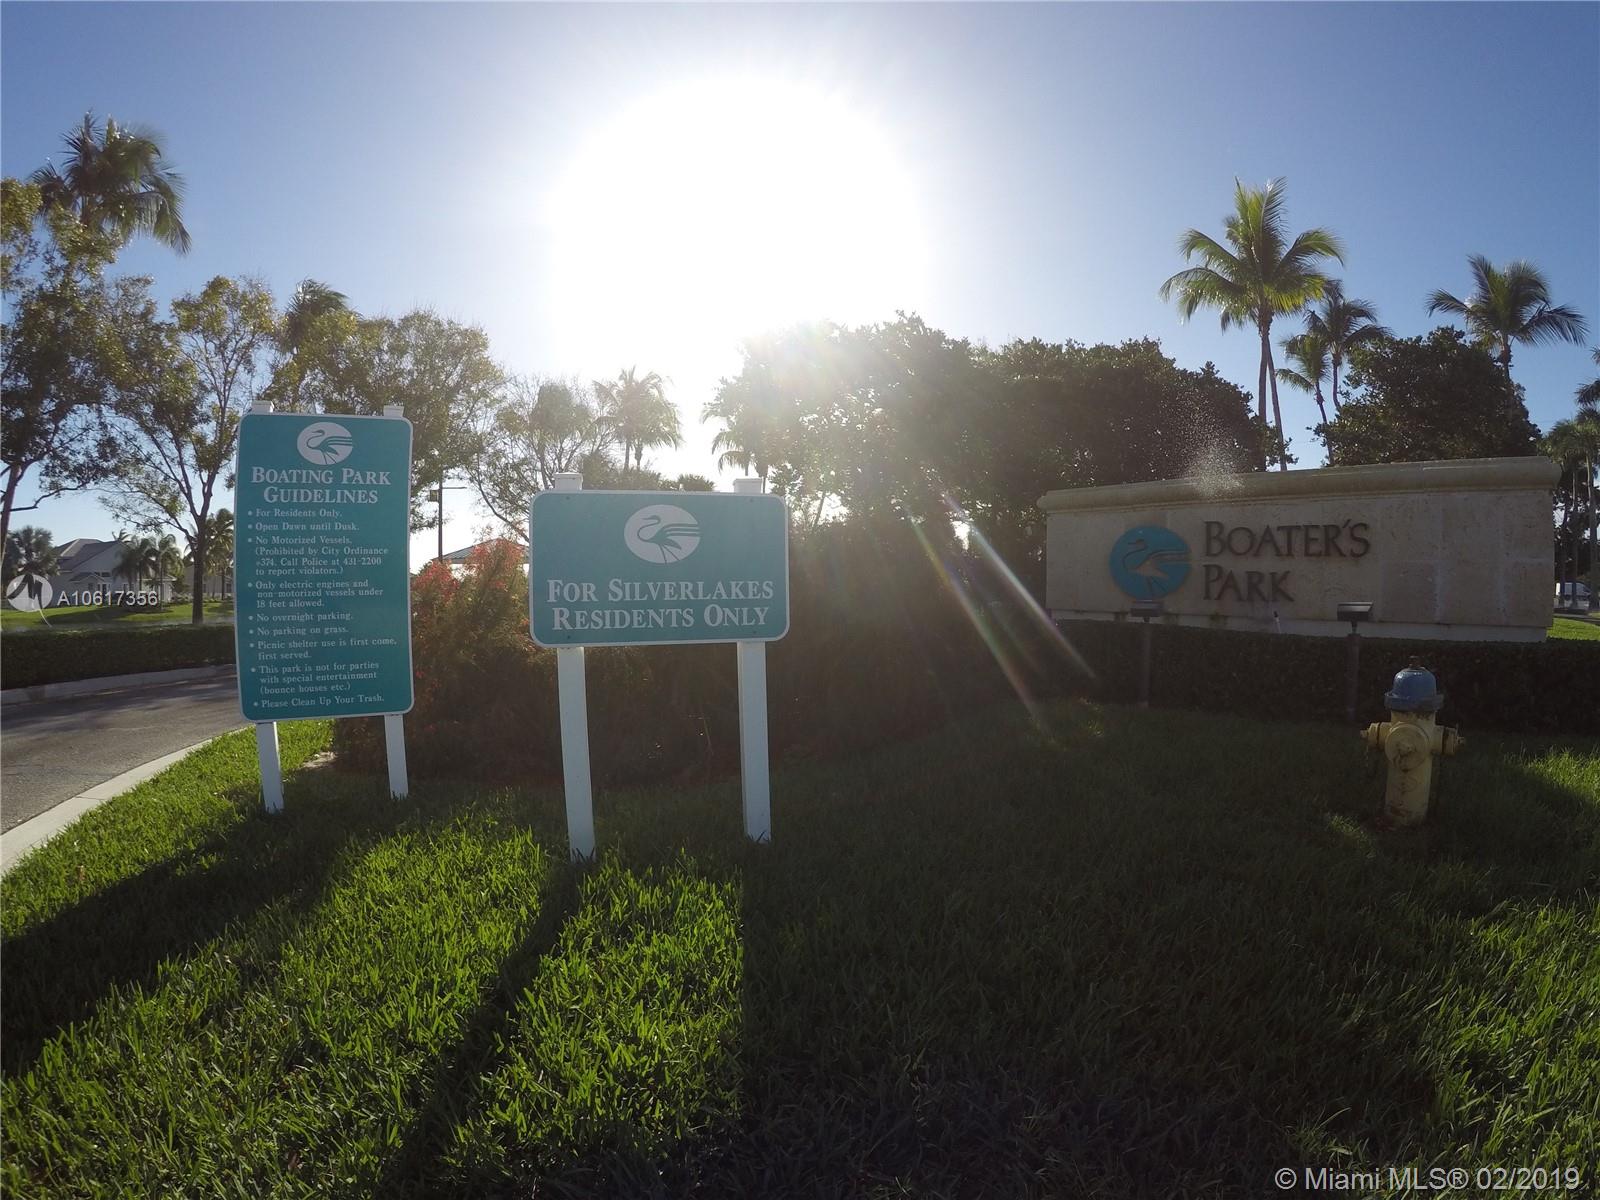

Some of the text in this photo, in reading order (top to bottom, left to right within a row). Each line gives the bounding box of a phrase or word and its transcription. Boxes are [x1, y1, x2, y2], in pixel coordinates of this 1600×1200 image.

[252, 466, 391, 486] BOATING PARK
[264, 486, 378, 504] GUIDELINES
[256, 508, 342, 519] For Residents Only.
[256, 523, 359, 532] Open Dawn until Dusk.
[256, 536, 268, 544] No
[272, 536, 315, 544] Motorized
[1201, 519, 1371, 558] BOATER'S
[309, 547, 318, 556] by
[321, 547, 339, 556] City
[344, 547, 388, 555] Ordinance
[281, 558, 298, 566] Call
[302, 558, 328, 566] Police
[332, 558, 339, 566] at
[343, 557, 381, 565] 431-2200
[268, 568, 295, 577] report
[256, 579, 368, 591] Only electric engines and
[1201, 564, 1295, 602] PARK
[325, 588, 355, 597] vessels
[359, 588, 383, 596] under
[547, 578, 774, 603] FOR SILVERLAKES
[257, 600, 265, 608] 18
[269, 600, 285, 608] feet
[257, 613, 269, 622] No
[273, 613, 313, 622] overnight
[552, 604, 770, 631] RESIDENTS ONLY
[258, 627, 269, 636] No
[273, 627, 306, 636] parking
[258, 641, 284, 649] Picnic
[289, 640, 317, 648] shelter
[339, 639, 347, 647] is
[350, 638, 368, 646] first
[258, 652, 276, 661] first
[260, 662, 379, 674] This park is not for parties
[260, 671, 376, 684] with special entertainment
[260, 685, 295, 695] (bounce
[299, 684, 327, 692] houses
[262, 694, 384, 708] Please Clean Up Your Trash.
